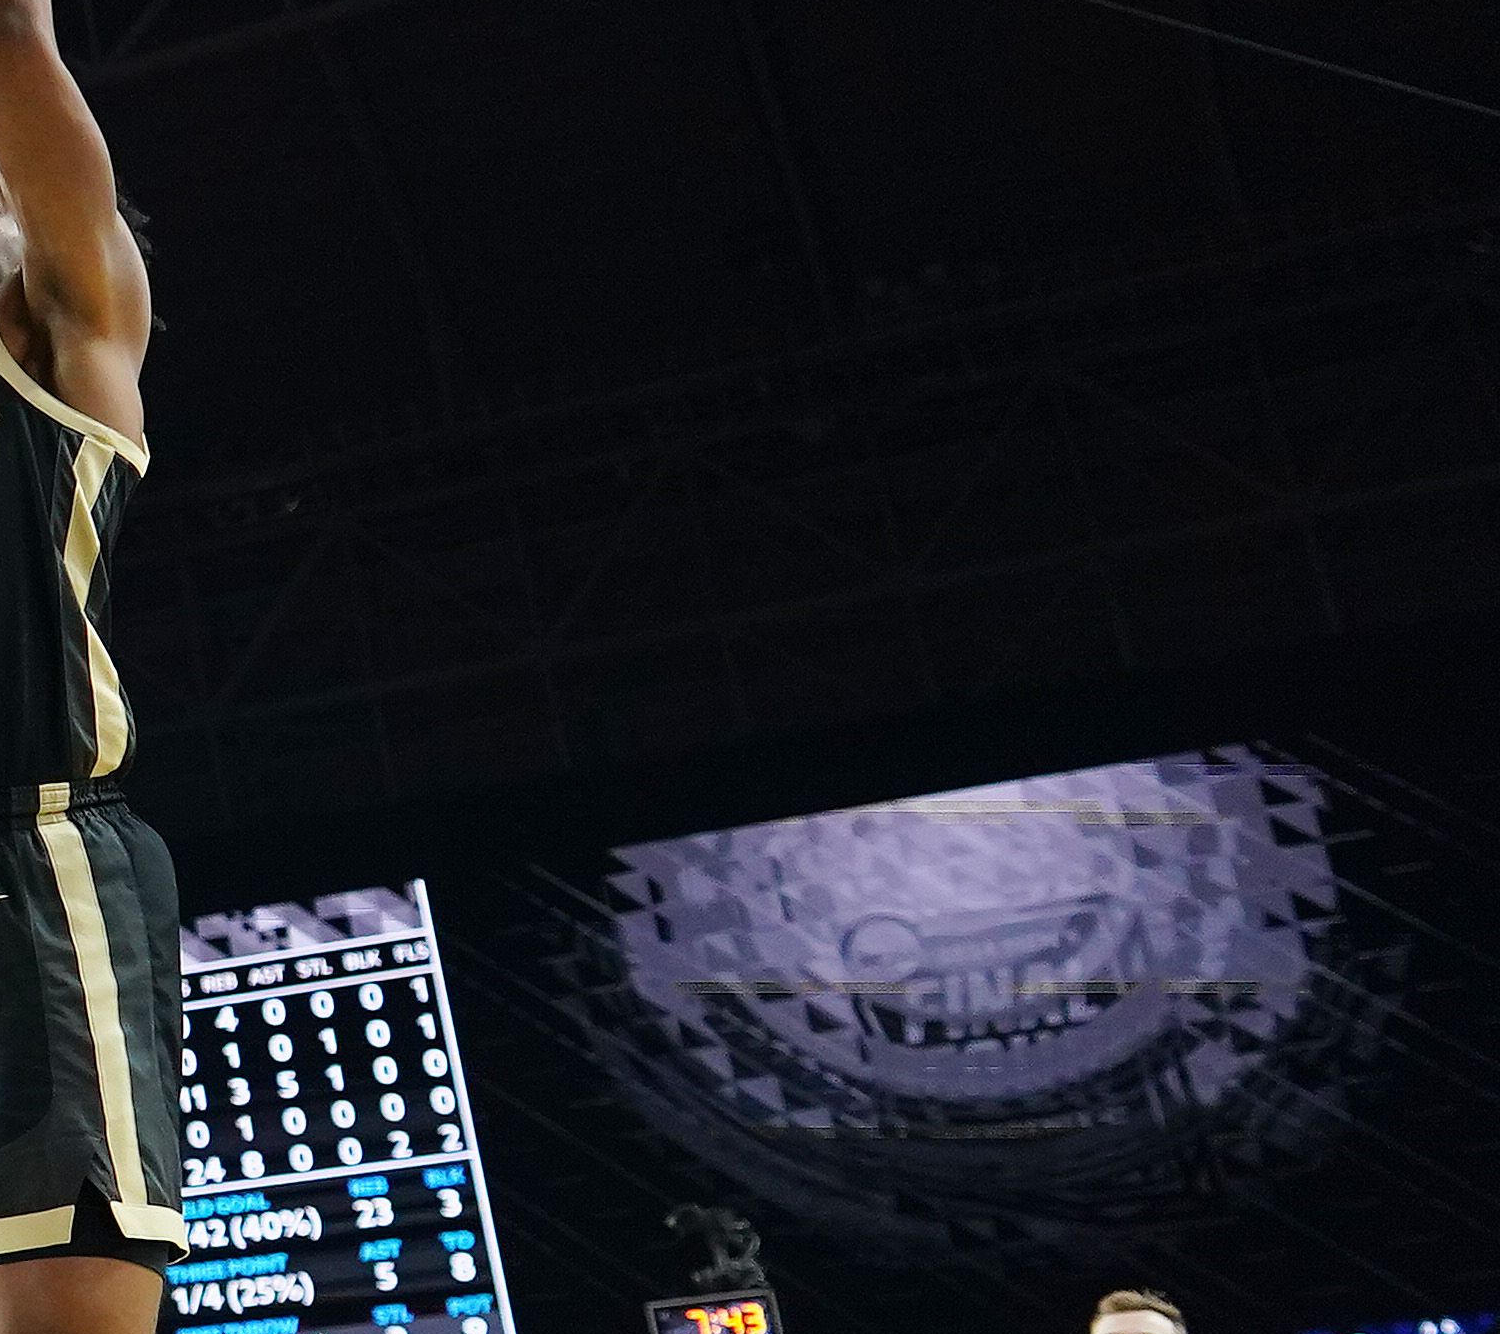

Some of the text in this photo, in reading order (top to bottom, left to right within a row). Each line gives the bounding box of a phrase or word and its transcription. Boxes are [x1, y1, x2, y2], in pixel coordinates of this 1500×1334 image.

[214, 976, 429, 1033] 4 0 0 0 1
[221, 1042, 241, 1069] 1
[268, 1033, 294, 1063] 0
[318, 1027, 338, 1055] 1
[365, 1019, 391, 1048] 0
[416, 1012, 437, 1040] 1
[227, 1077, 251, 1106] 3
[276, 1070, 300, 1099] 5
[324, 1063, 345, 1092] 1
[372, 1055, 399, 1085] 0
[422, 1048, 448, 1078] 0
[185, 1085, 456, 1149] 0 1 0 0 0 0
[182, 1123, 464, 1187] 24 8 0 0 2 2
[229, 1205, 322, 1250] (40%)
[351, 1197, 394, 1229] 23
[438, 1188, 463, 1218] 3
[171, 1270, 315, 1315] 1/4 (25%)
[374, 1261, 398, 1291] 5
